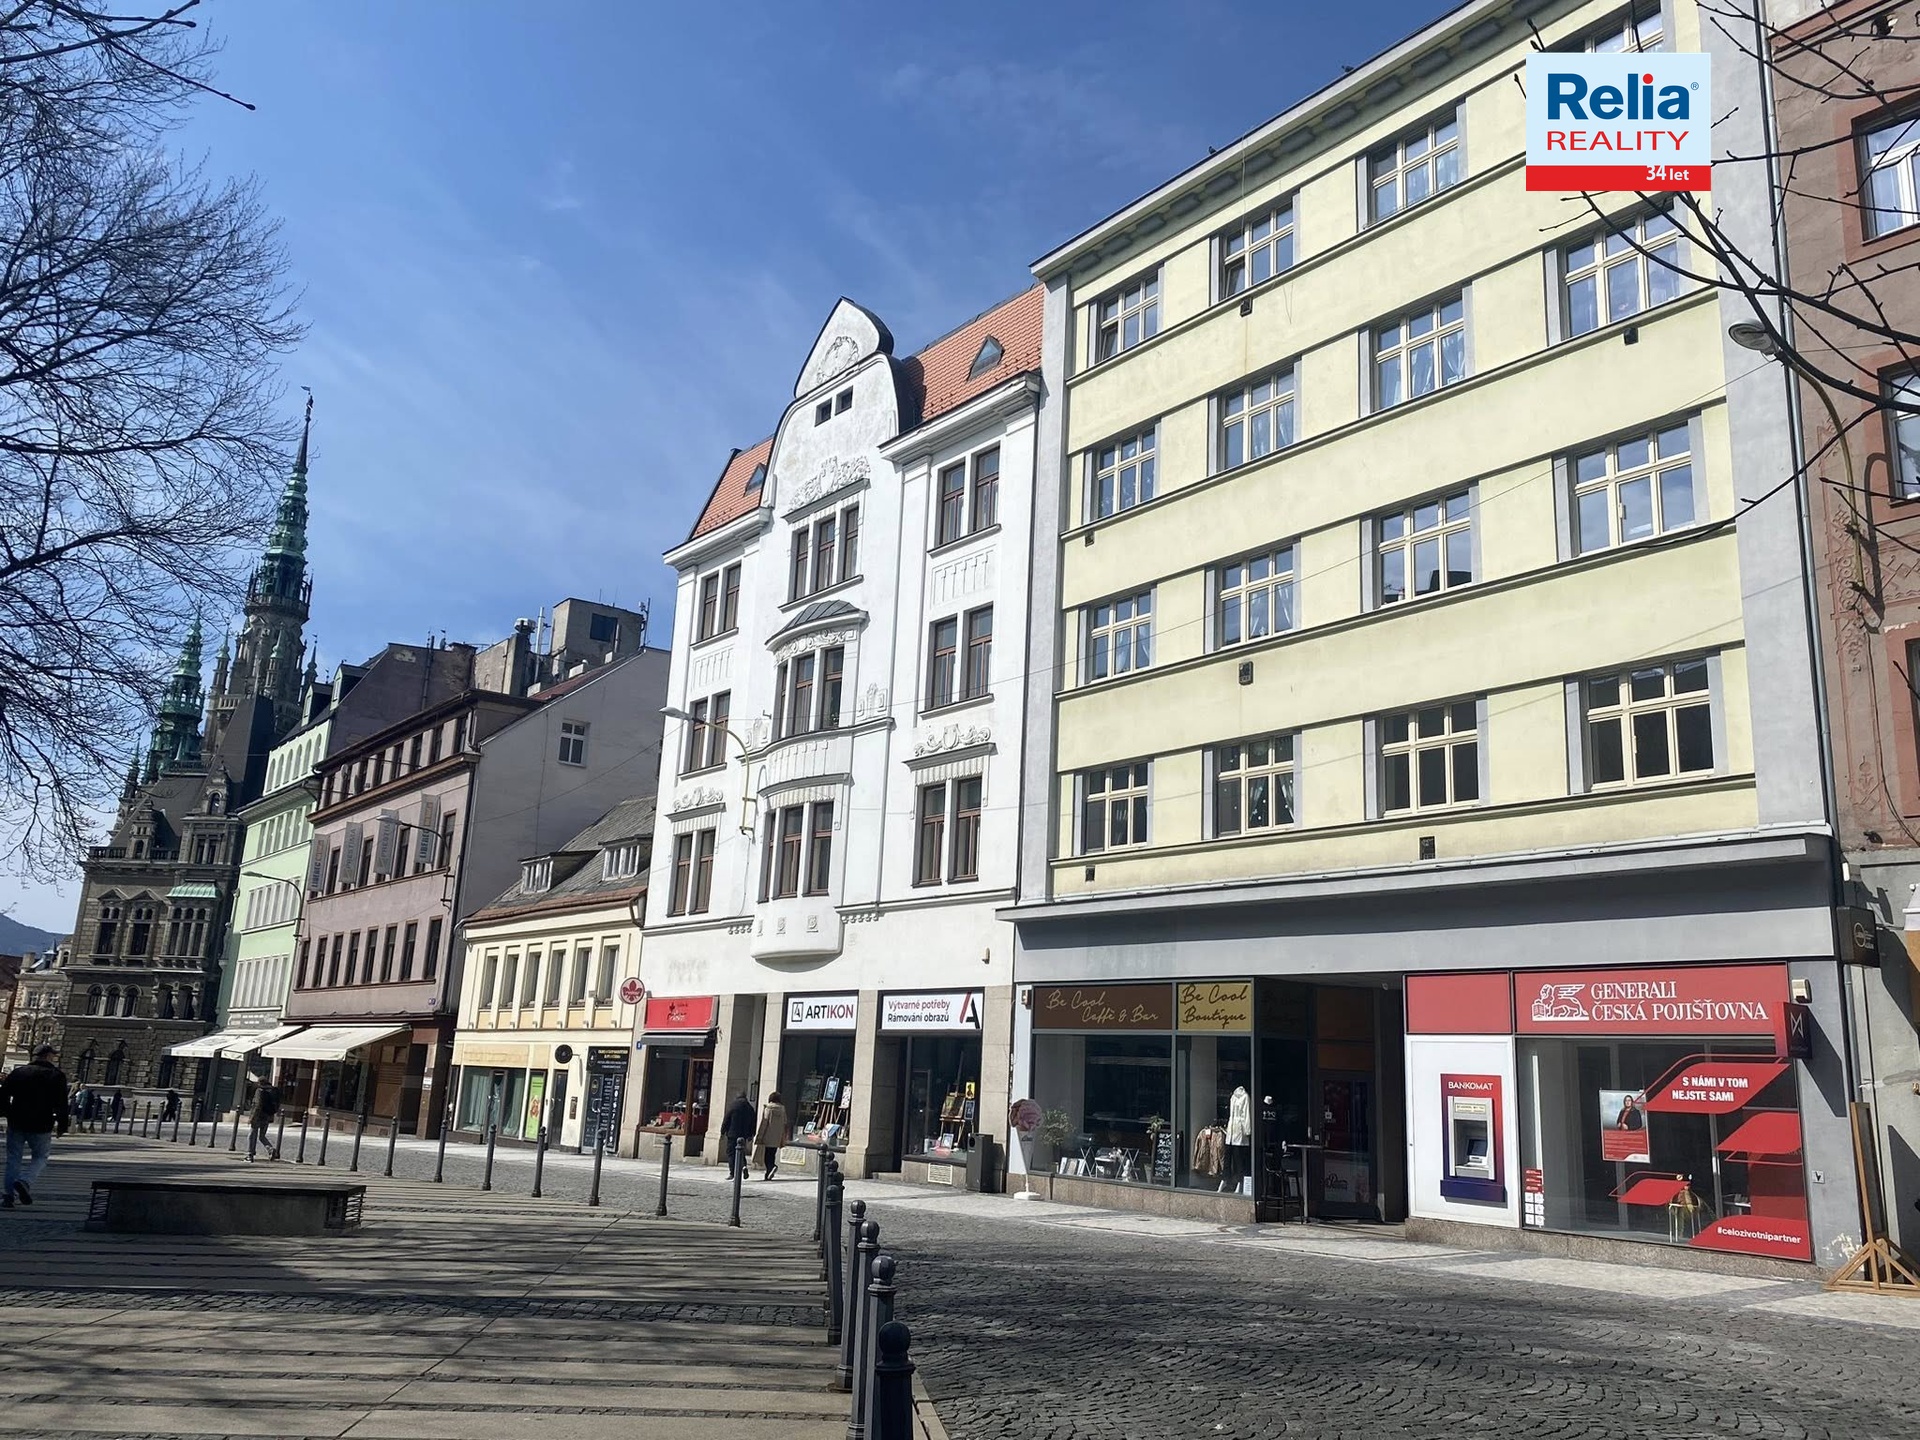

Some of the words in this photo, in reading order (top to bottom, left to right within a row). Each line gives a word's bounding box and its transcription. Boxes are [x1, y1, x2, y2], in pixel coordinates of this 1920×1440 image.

[1045, 989, 1068, 1010] Be
[1071, 990, 1106, 1010] Cool
[1180, 983, 1204, 1005] Be
[1208, 984, 1249, 1004] Cool
[1590, 981, 1677, 1000] GENERALI
[805, 1004, 854, 1019] ARTIKON
[888, 999, 920, 1012] Výtvarné
[921, 998, 951, 1011] potřeby
[1130, 1004, 1159, 1023] Bar
[1591, 1000, 1648, 1021] ČESKÁ
[1652, 999, 1769, 1021] POJIŠŤOVNA
[887, 1012, 923, 1023] Rámování
[923, 1011, 950, 1022] obrazů
[1183, 1005, 1247, 1029] Boutique
[1448, 1081, 1494, 1091] BANKOMAT
[1682, 1076, 1689, 1087] S
[1691, 1074, 1717, 1087] NÁMI
[1718, 1077, 1725, 1087] V
[1726, 1077, 1748, 1088] TOM
[1672, 1090, 1707, 1101] NEJSTE
[1708, 1091, 1735, 1102] SAMI
[1717, 1226, 1802, 1244] #celozivotnipartner
